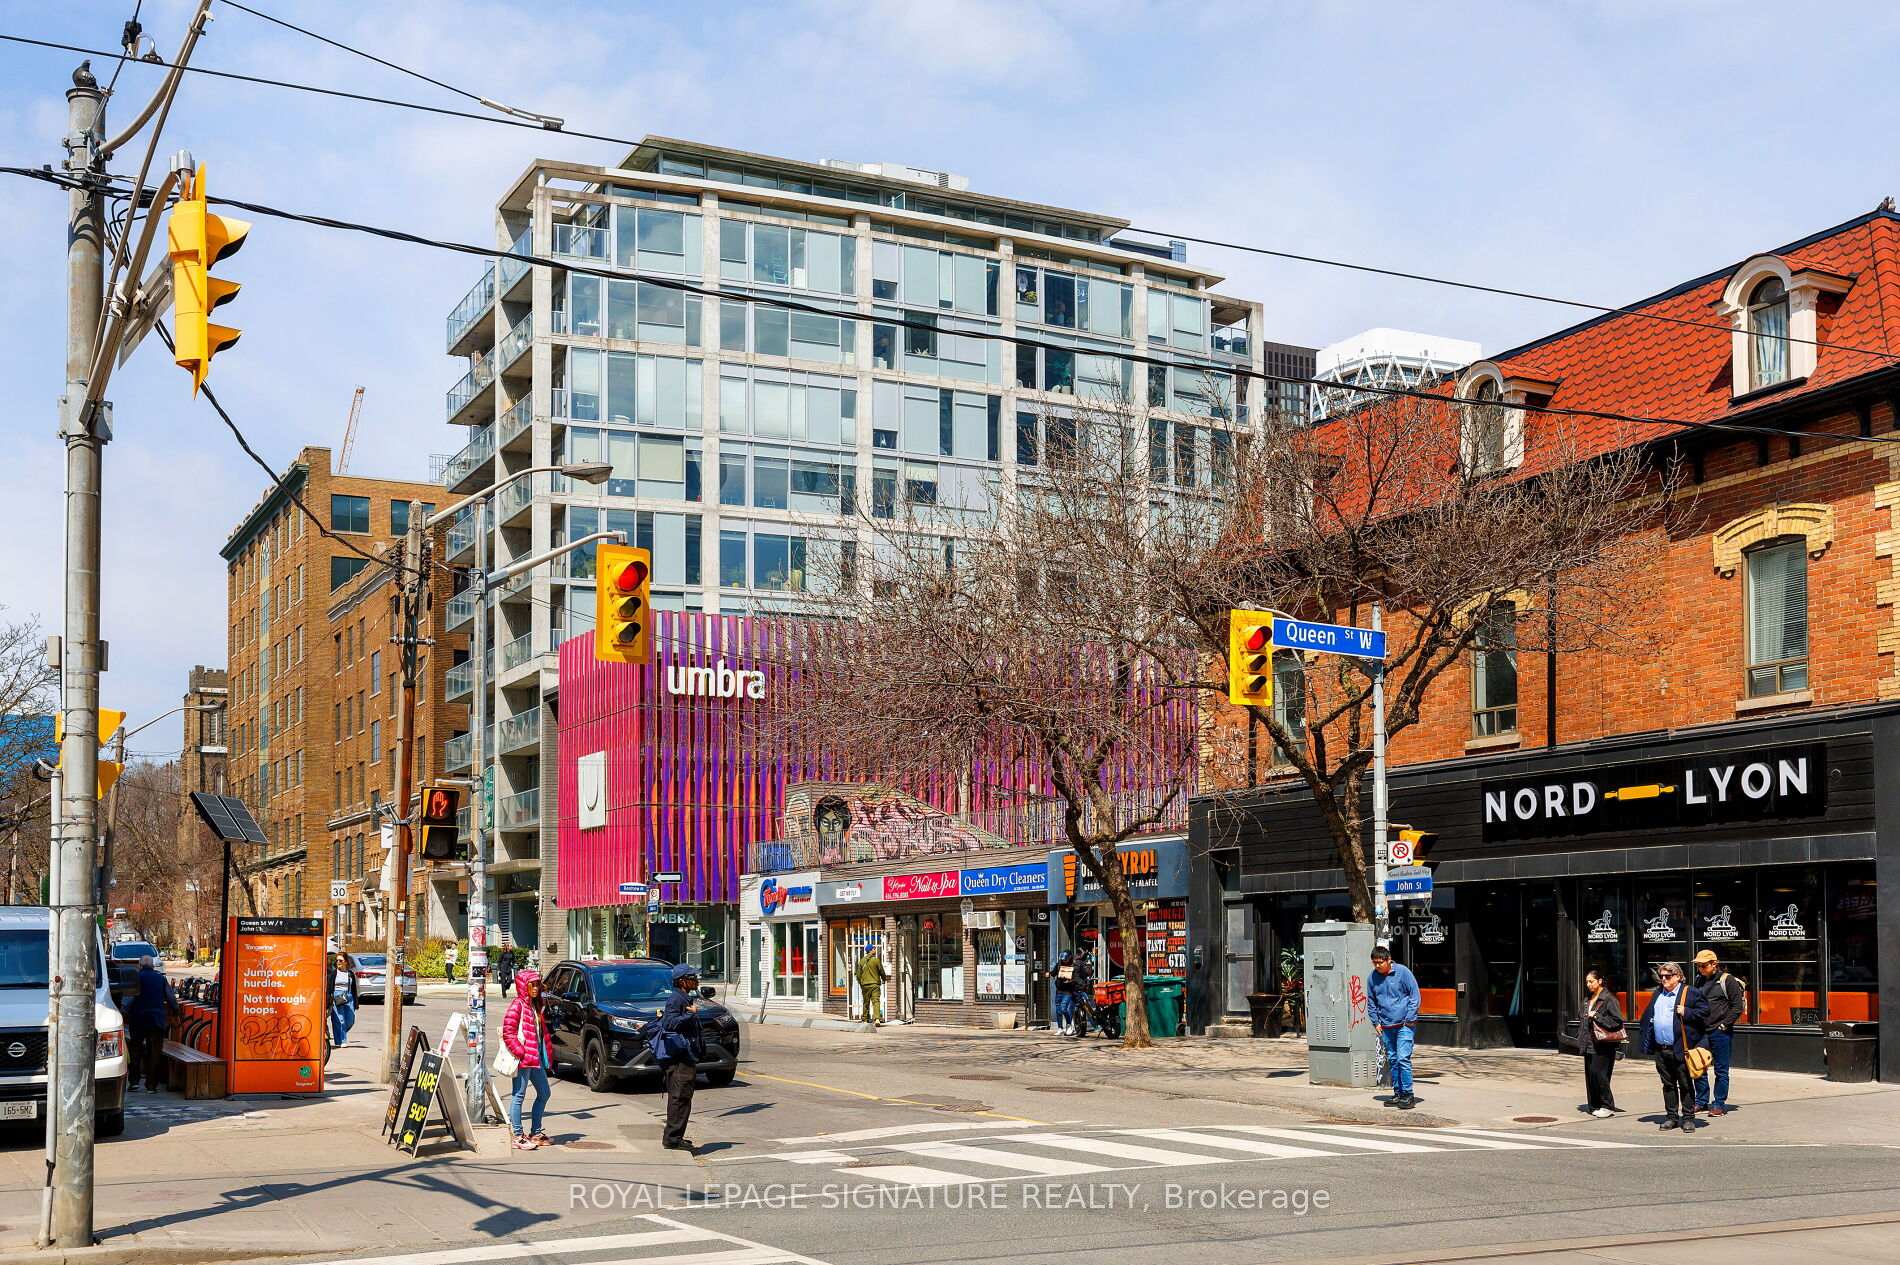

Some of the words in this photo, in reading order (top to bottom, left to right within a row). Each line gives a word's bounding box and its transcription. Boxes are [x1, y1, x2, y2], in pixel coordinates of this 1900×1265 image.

[1286, 622, 1336, 645] Queen
[1344, 629, 1354, 640] St
[1359, 631, 1373, 650] W
[667, 660, 766, 699] umbra
[1486, 782, 1597, 823] NORD
[1685, 758, 1808, 805] LYON
[909, 876, 932, 893] Nail
[937, 873, 958, 895] Spa
[964, 876, 990, 890] Queen
[992, 874, 1008, 890] Dry
[1009, 872, 1045, 885] Cleaners
[1396, 881, 1413, 891] John
[1416, 881, 1422, 890] St
[333, 888, 345, 897] 30
[244, 968, 274, 978] Jump
[243, 978, 285, 988] hurdles.
[243, 994, 262, 1003] Not
[265, 994, 306, 1005] through
[243, 1005, 278, 1015] hoops.
[417, 1071, 438, 1092] VAPE
[409, 1103, 427, 1121] SHOP
